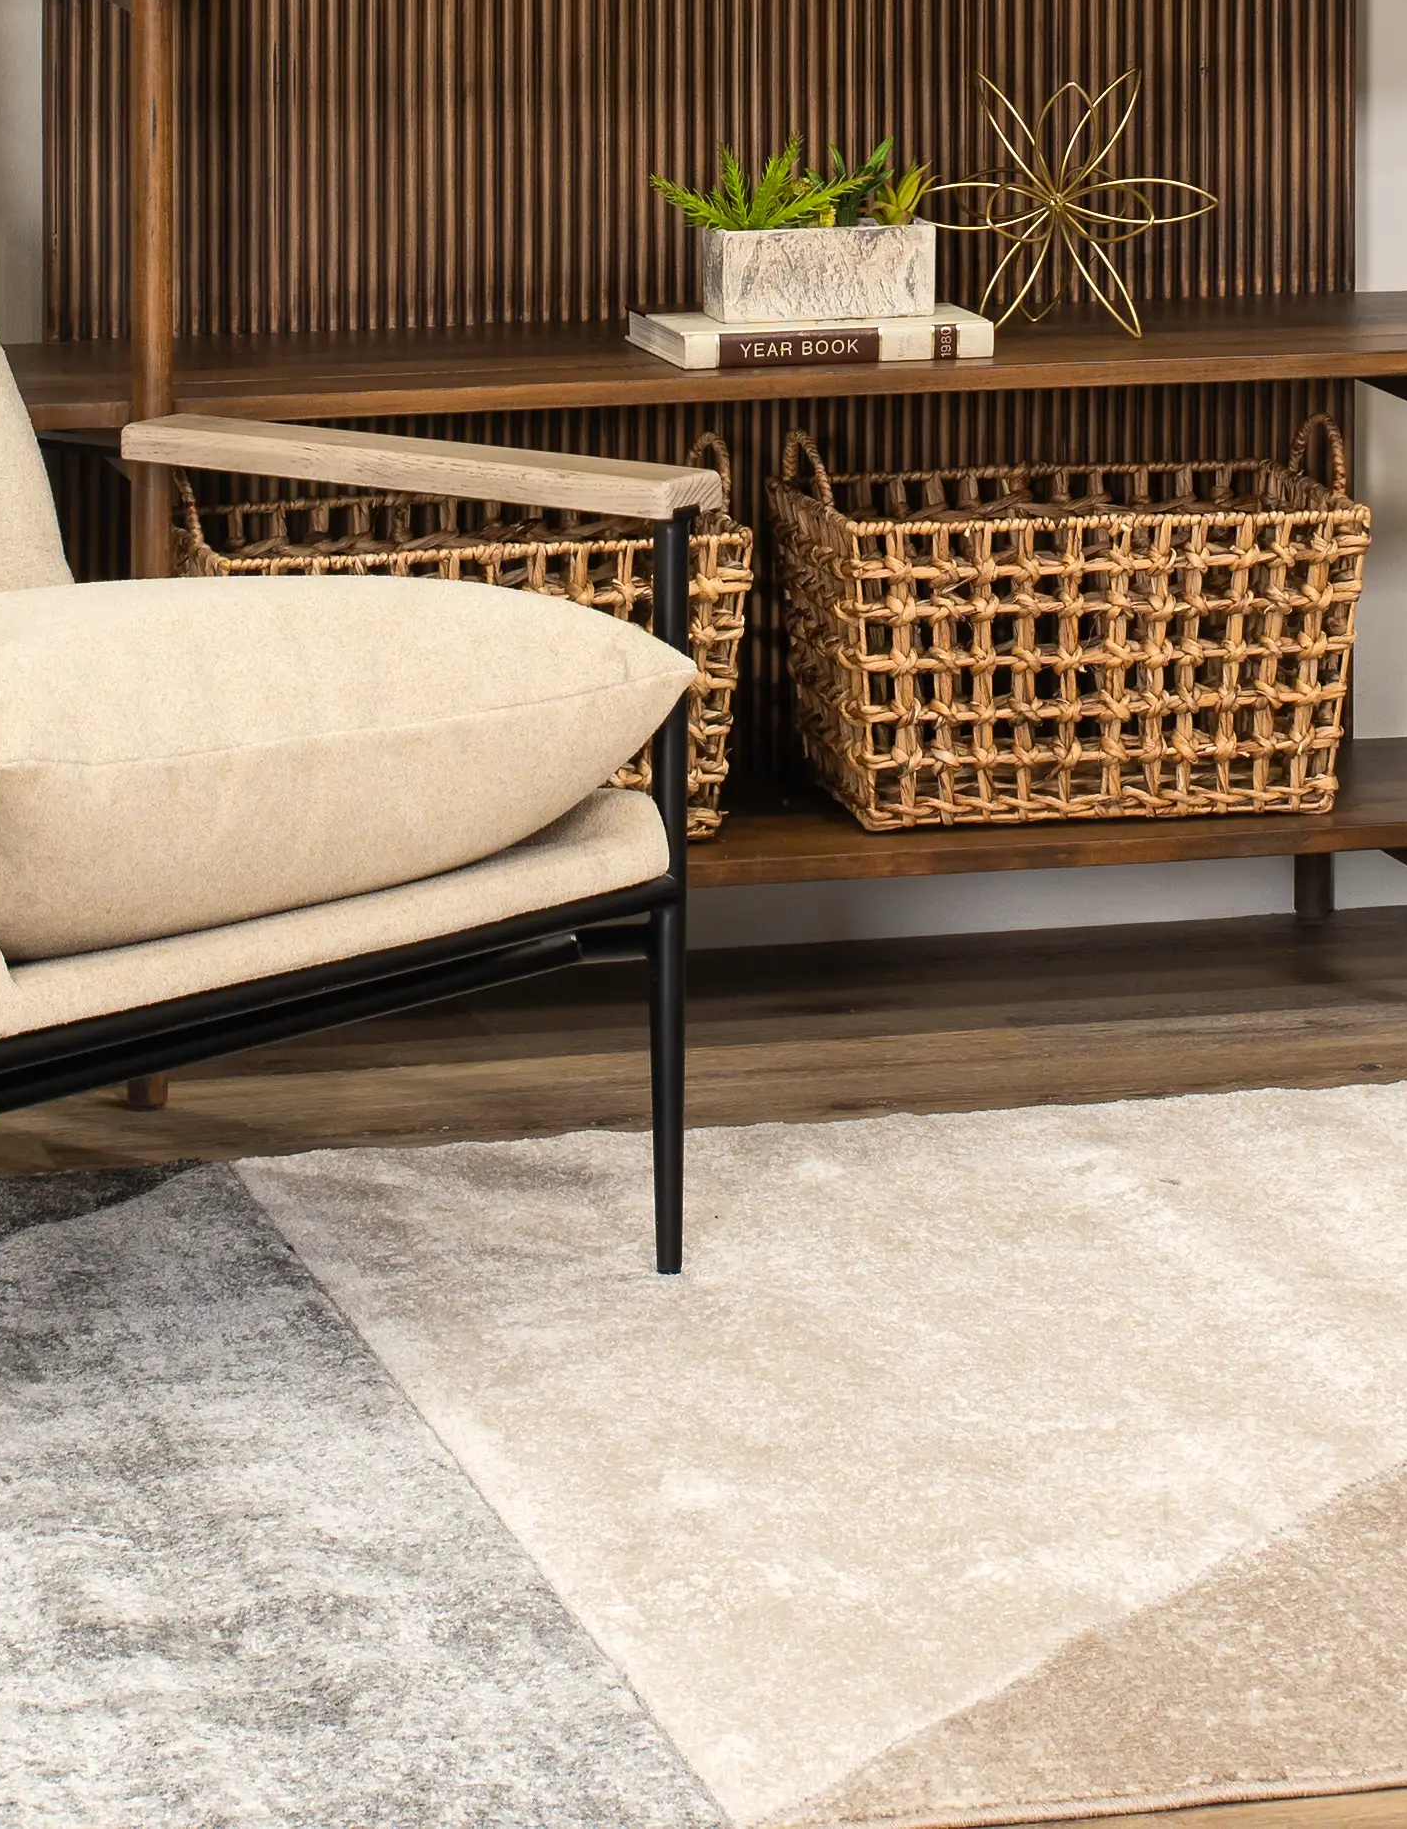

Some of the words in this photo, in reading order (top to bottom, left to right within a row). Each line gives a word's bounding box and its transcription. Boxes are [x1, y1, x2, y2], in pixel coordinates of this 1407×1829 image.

[740, 341, 793, 359] YEAR
[801, 338, 859, 356] BOOK
[940, 325, 952, 358] 1980
